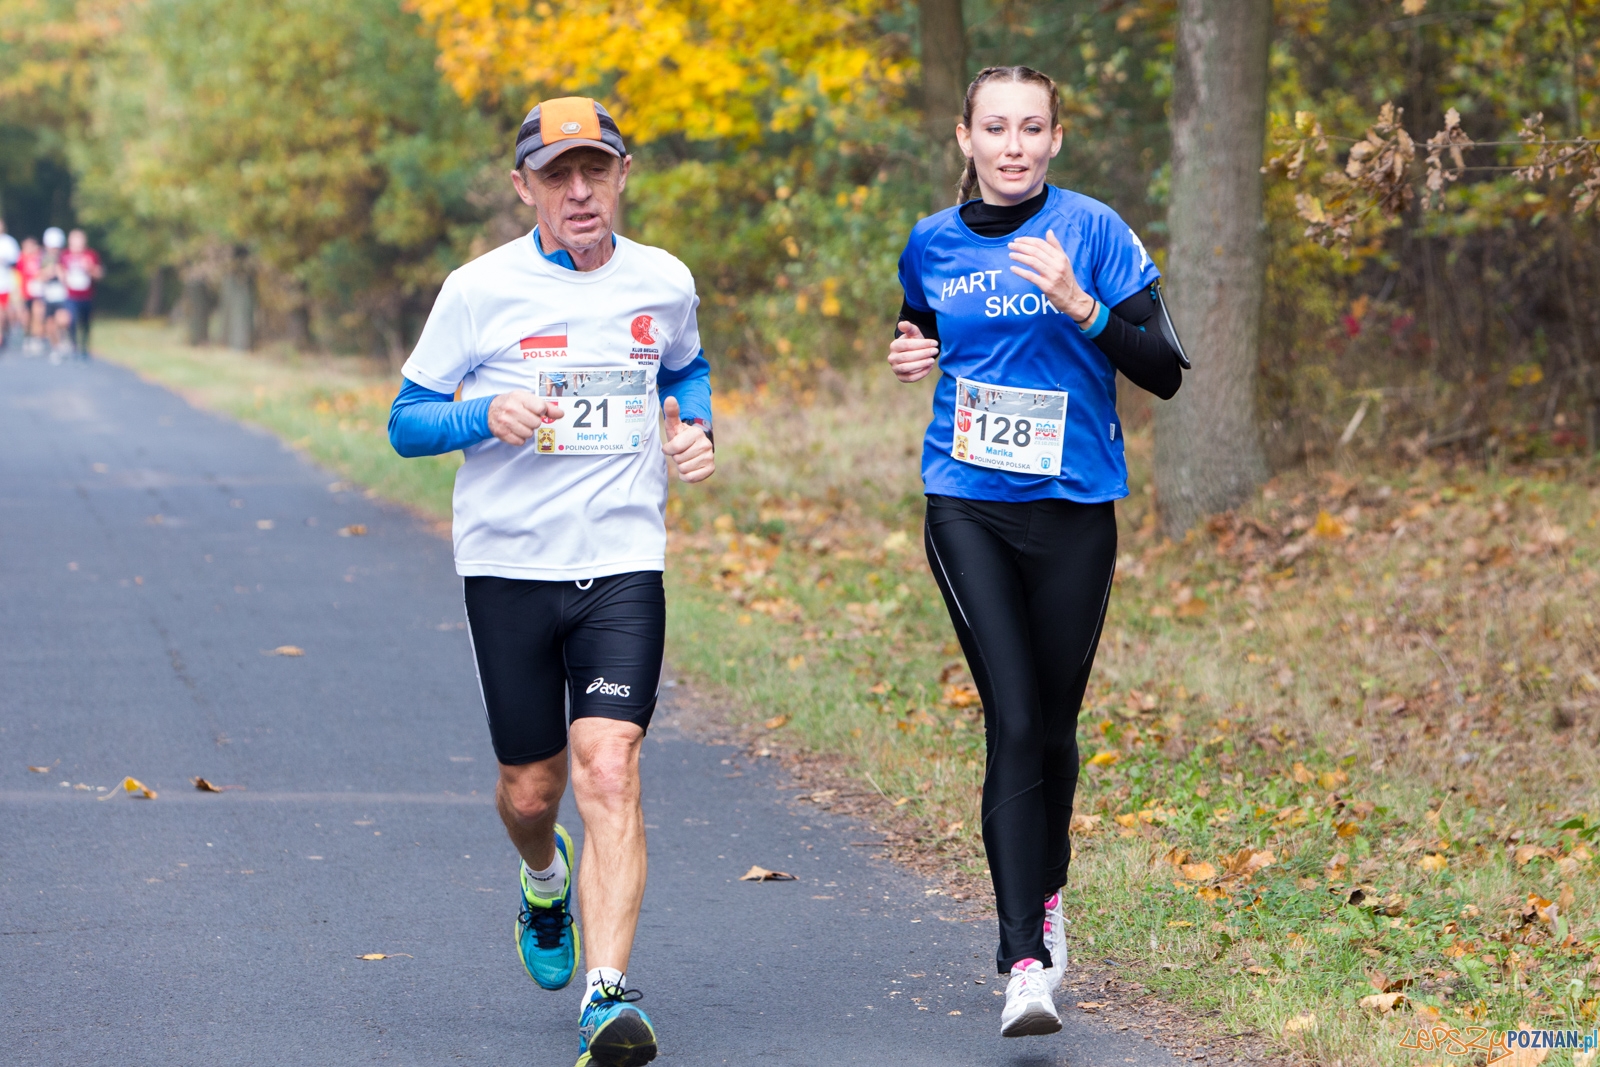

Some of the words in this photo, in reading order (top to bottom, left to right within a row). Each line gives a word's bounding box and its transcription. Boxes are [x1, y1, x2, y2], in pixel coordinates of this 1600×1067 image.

[941, 269, 1002, 301] HART
[985, 293, 1064, 317] SKOK
[522, 349, 568, 360] POLSKA
[572, 398, 609, 428] 21
[576, 432, 608, 442] Henryk
[975, 413, 1031, 448] 128
[985, 445, 1013, 458] Marika
[974, 455, 1005, 466] POLINOVA
[1005, 461, 1031, 470] POLSKA
